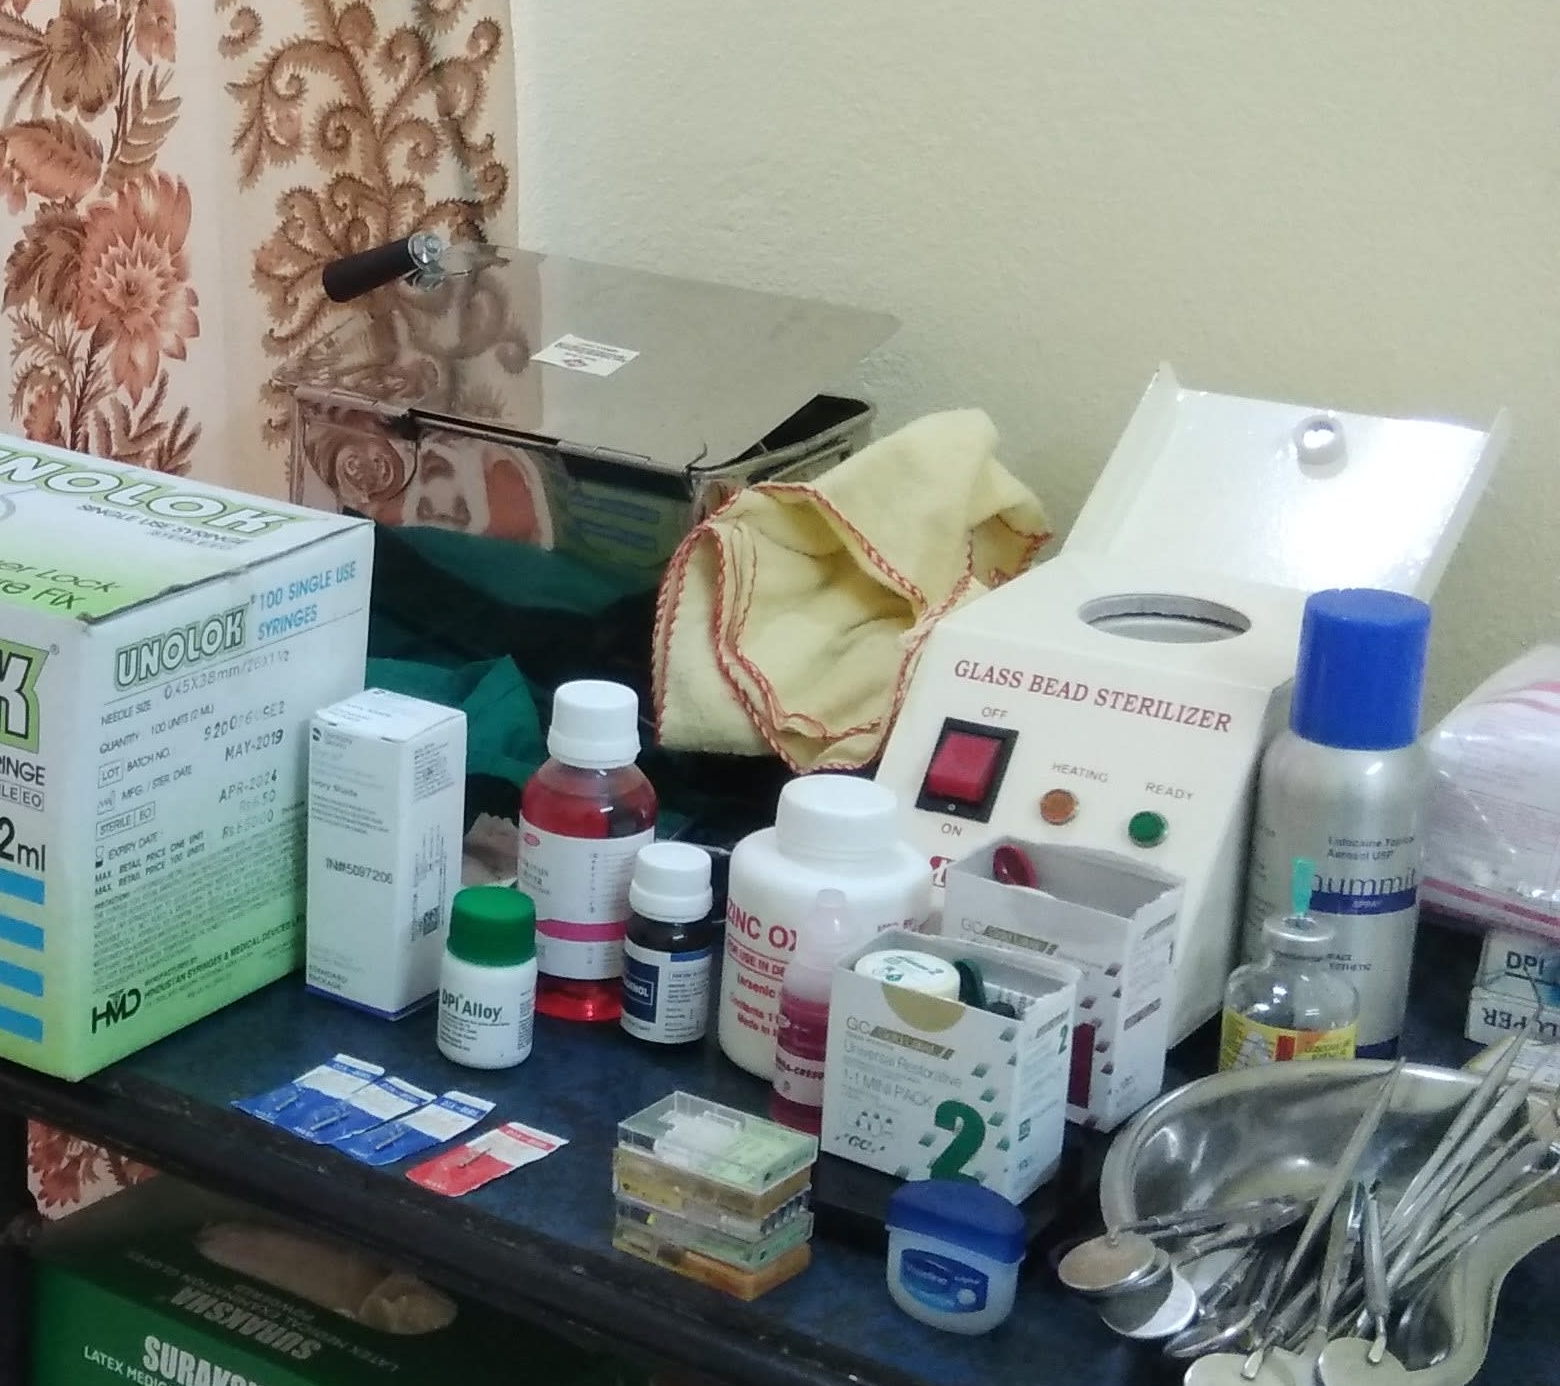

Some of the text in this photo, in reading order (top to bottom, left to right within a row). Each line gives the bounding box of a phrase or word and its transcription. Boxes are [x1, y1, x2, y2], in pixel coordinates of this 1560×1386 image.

[33, 568, 121, 594] Lock
[258, 561, 356, 611] 100 SINGLE USE
[257, 604, 318, 640] SYRINGES
[116, 608, 248, 687] UNOLOK
[953, 659, 1233, 733] GLASS BEAD STERILIZER
[981, 706, 1009, 720] OFF
[224, 728, 284, 762] MAY-2019
[101, 766, 121, 783] LOT
[1051, 762, 1109, 784] HEATING
[21, 791, 42, 808] EO
[1145, 781, 1195, 801] READY
[99, 817, 132, 836] STERILE
[940, 823, 963, 838] ON
[1506, 950, 1545, 976] DPI
[91, 987, 142, 1034] HMD
[441, 988, 503, 1023] DPI Alloy
[846, 1016, 871, 1034] GC
[933, 1099, 987, 1182] 2
[83, 1345, 124, 1376] LATEX
